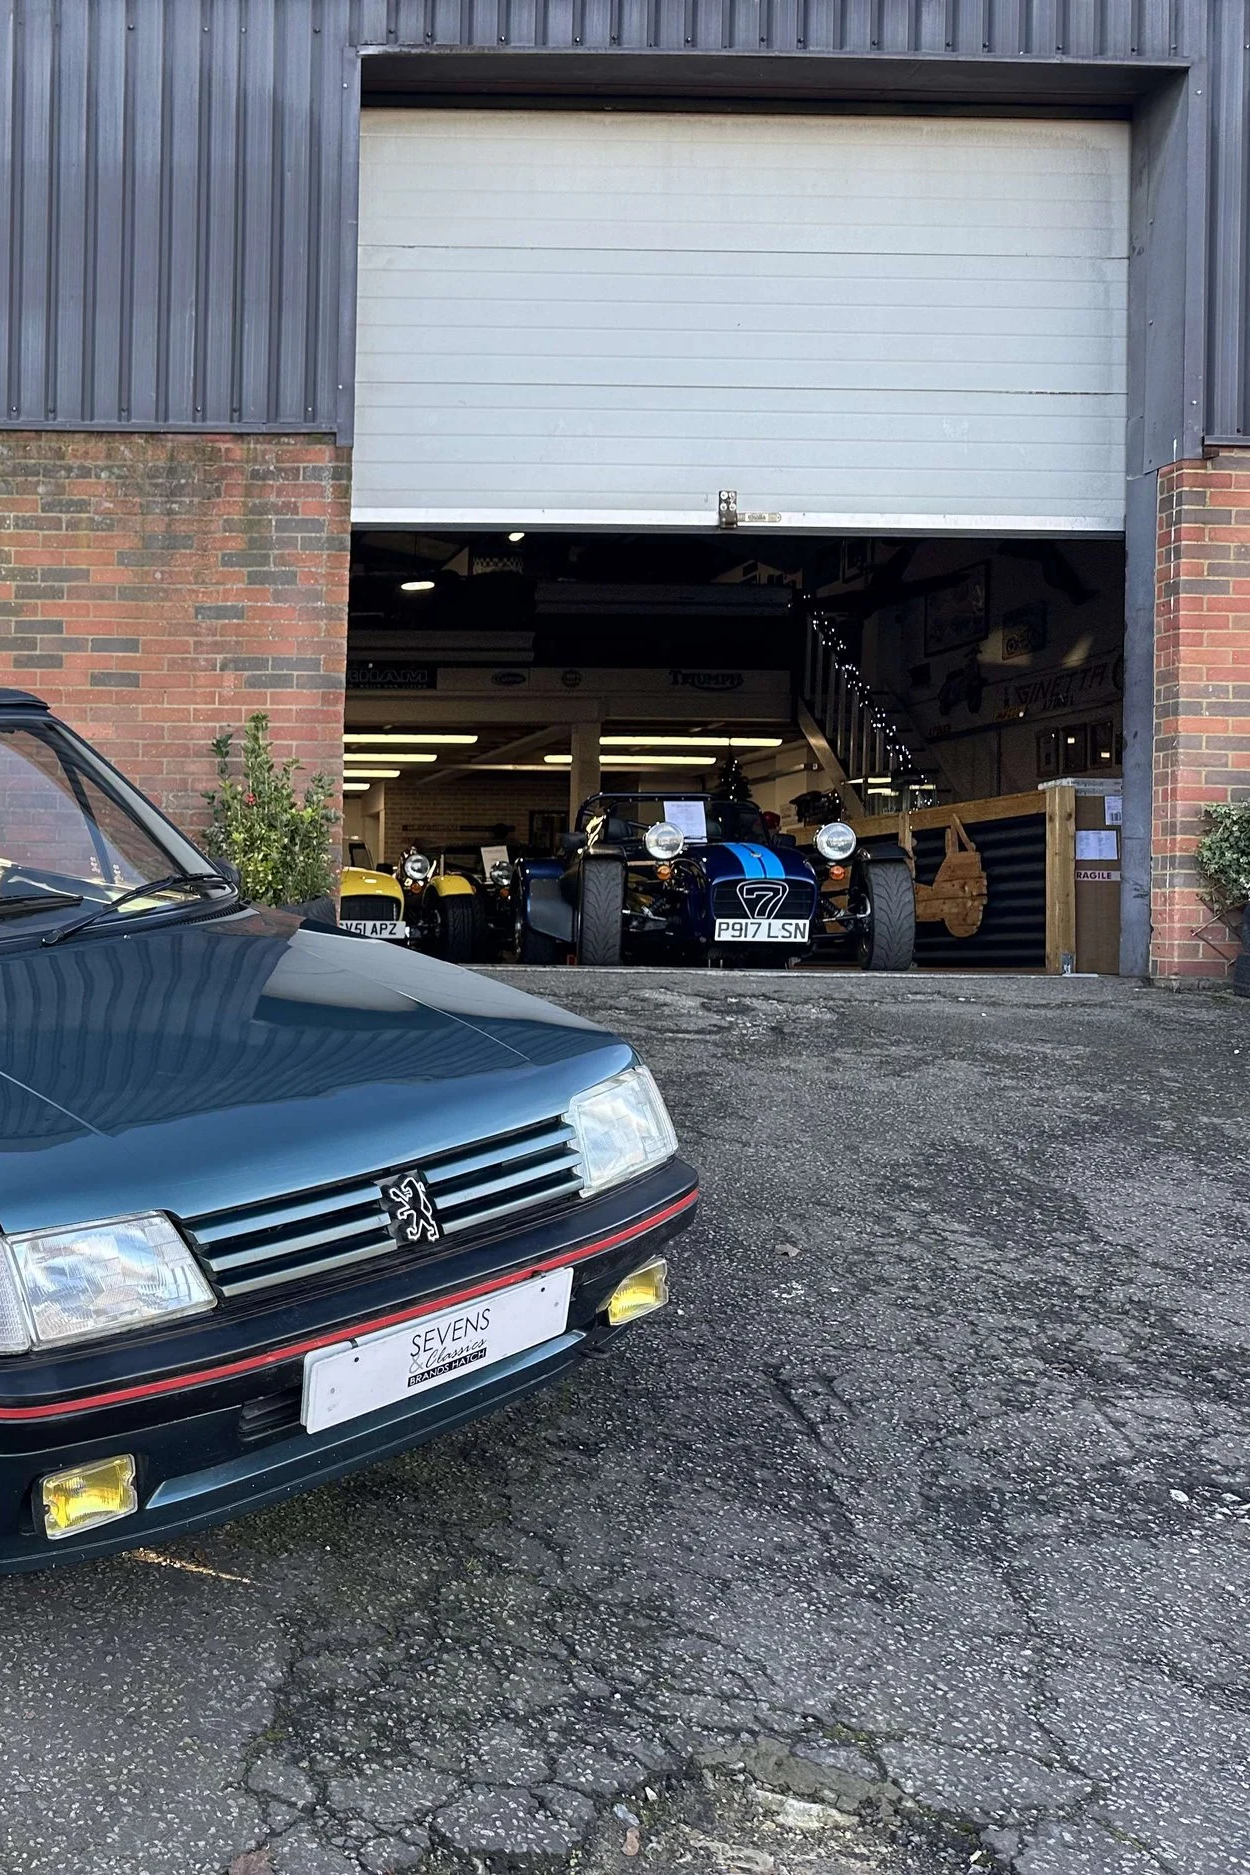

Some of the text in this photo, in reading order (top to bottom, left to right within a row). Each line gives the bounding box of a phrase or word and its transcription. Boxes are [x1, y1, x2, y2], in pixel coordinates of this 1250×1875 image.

[1076, 871, 1112, 880] RAGILE
[743, 884, 783, 919] 7
[340, 922, 397, 936] V51 APZ
[717, 921, 807, 939] P917 LSN
[410, 1308, 491, 1357] SEVENS
[409, 1338, 488, 1374] & Classics
[409, 1348, 486, 1387] BRANDS HATCH
